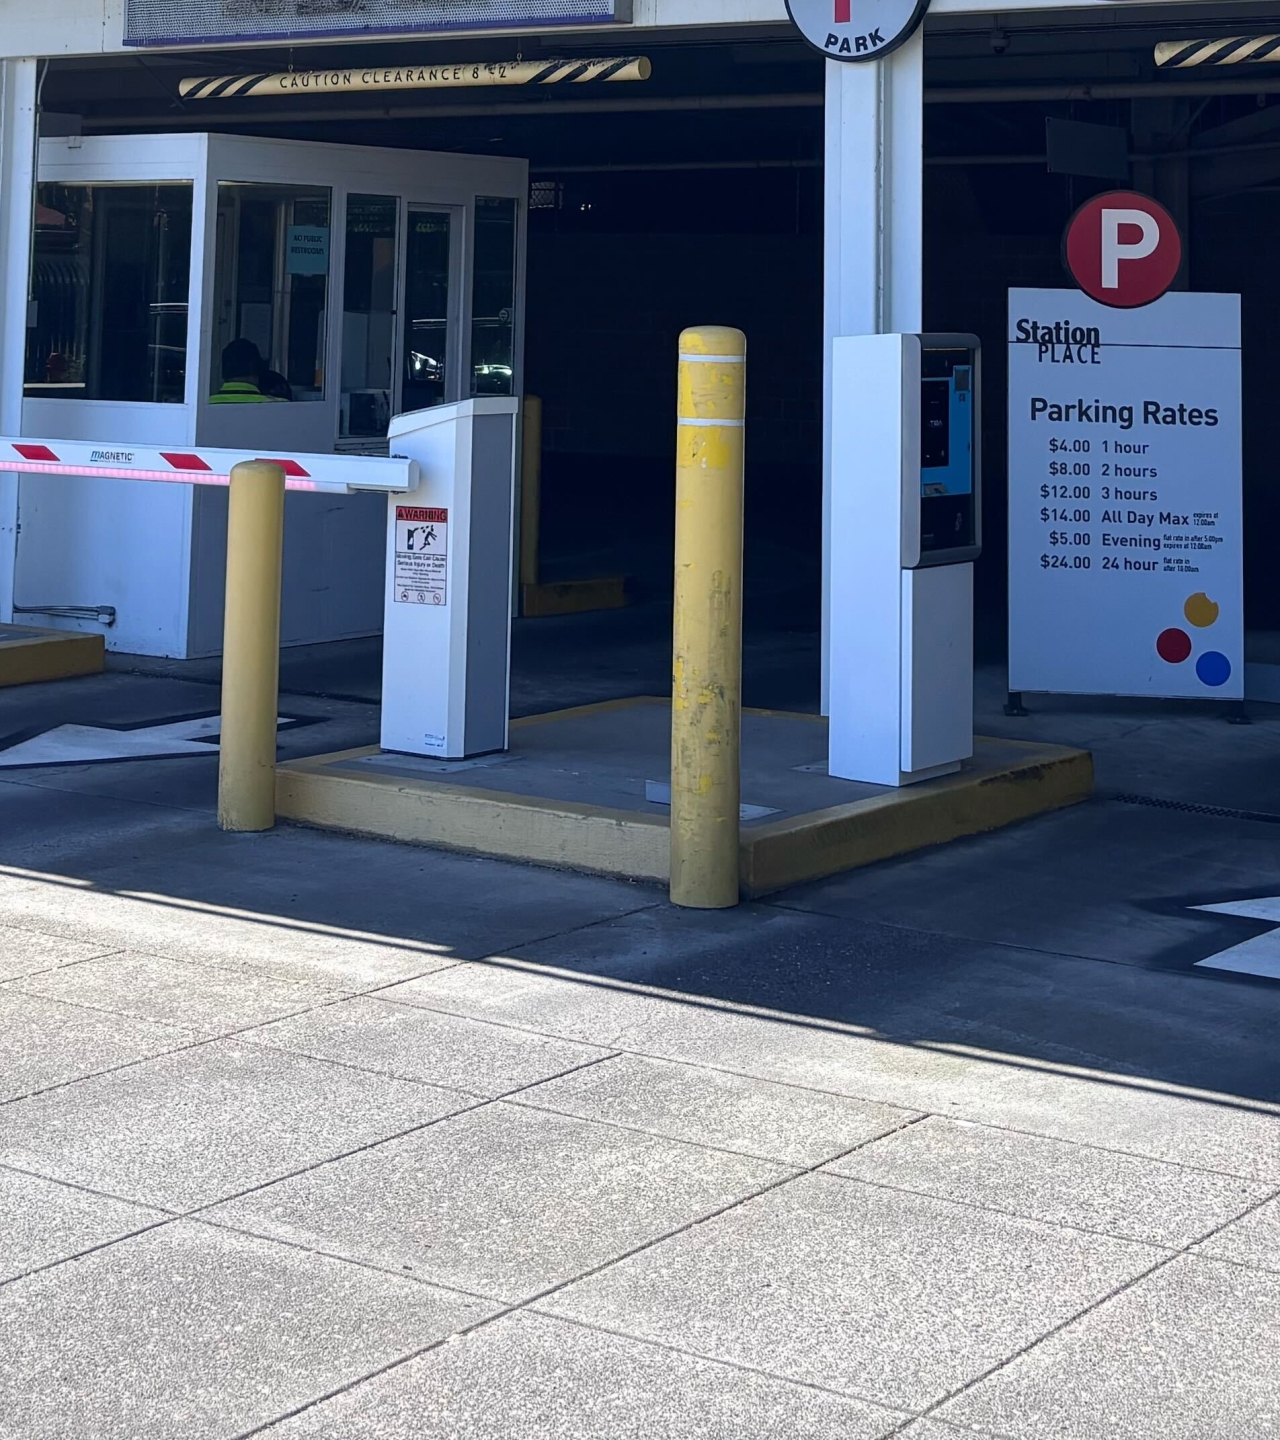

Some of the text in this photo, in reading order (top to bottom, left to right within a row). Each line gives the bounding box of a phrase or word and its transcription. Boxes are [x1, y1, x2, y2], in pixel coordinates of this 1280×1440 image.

[824, 27, 885, 53] PARK
[279, 71, 352, 89] CAUTION
[362, 67, 460, 84] CLEARANCE
[1100, 208, 1160, 289] P
[1015, 318, 1100, 345] Station
[1038, 343, 1101, 364] PLACE
[1030, 397, 1219, 430] Parking Rates
[1049, 437, 1149, 454] $4.00 1 hour
[1049, 461, 1158, 478] $8.00 2 hours
[1040, 484, 1158, 501] $12.00 3 hours
[405, 509, 447, 521] WARNING
[1040, 507, 1189, 527] $14.00 All Day Max
[1049, 530, 1161, 550] $5.00 Evening
[1040, 553, 1159, 571] $24.00 24 hour
